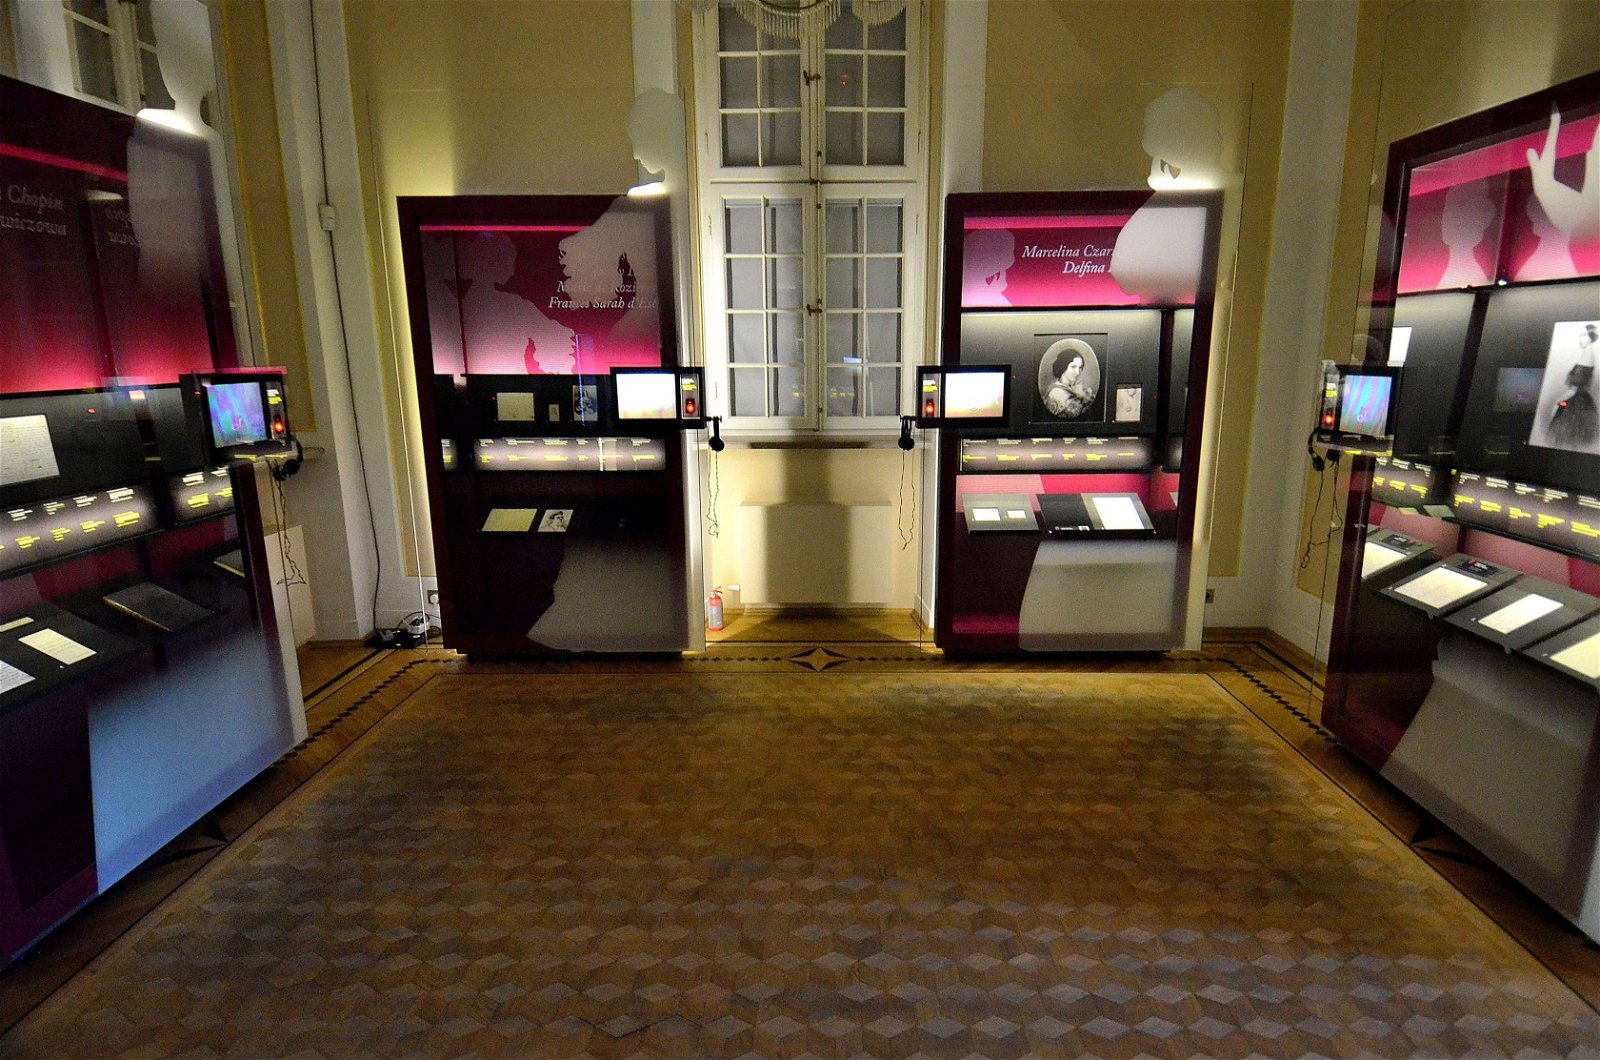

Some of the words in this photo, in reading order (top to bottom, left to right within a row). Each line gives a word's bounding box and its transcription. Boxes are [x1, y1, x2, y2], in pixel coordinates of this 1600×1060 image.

[7, 184, 64, 214] Chopin
[1021, 245, 1080, 258] Marcelina
[1062, 260, 1105, 278] Delfina
[592, 296, 626, 309] Sarah
